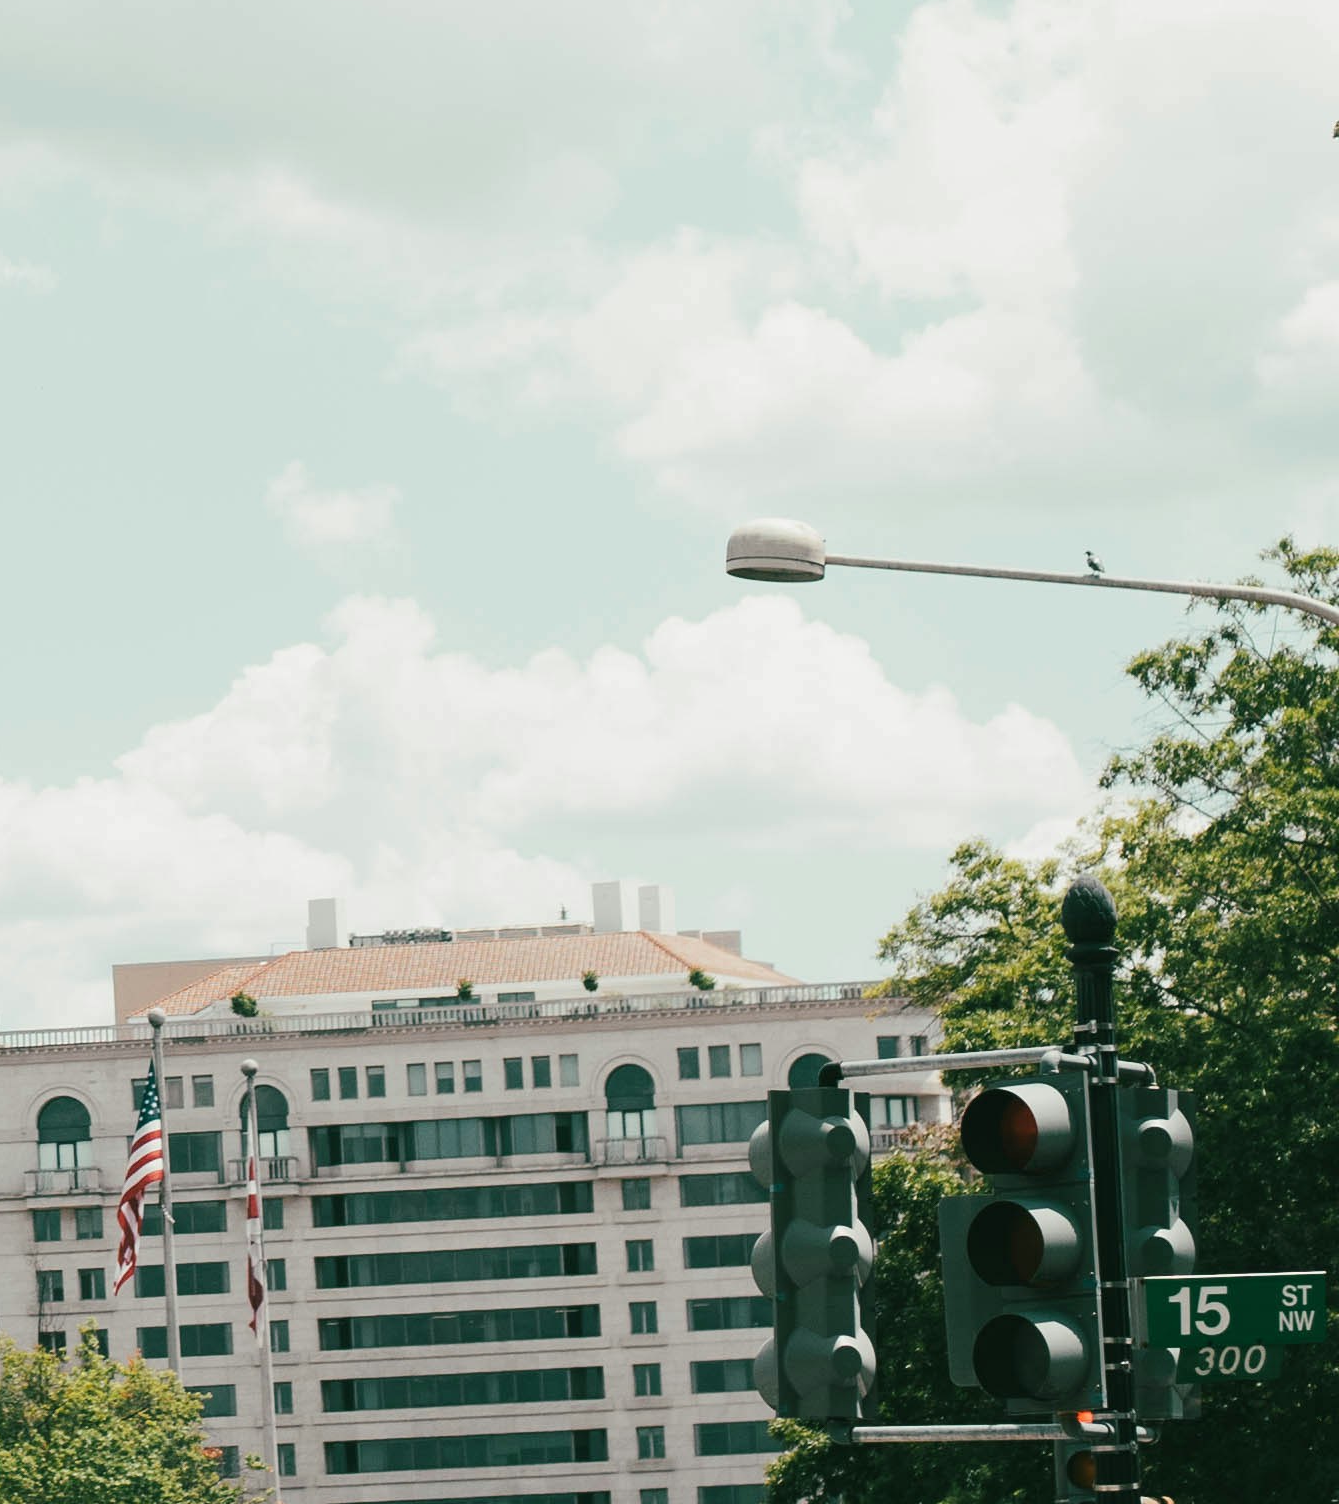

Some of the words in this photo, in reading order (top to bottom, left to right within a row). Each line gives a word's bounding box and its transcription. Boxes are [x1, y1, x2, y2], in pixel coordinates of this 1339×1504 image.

[1282, 1284, 1312, 1306] ST
[1168, 1285, 1231, 1336] 15
[1278, 1310, 1315, 1332] NW
[1194, 1344, 1267, 1377] 300
